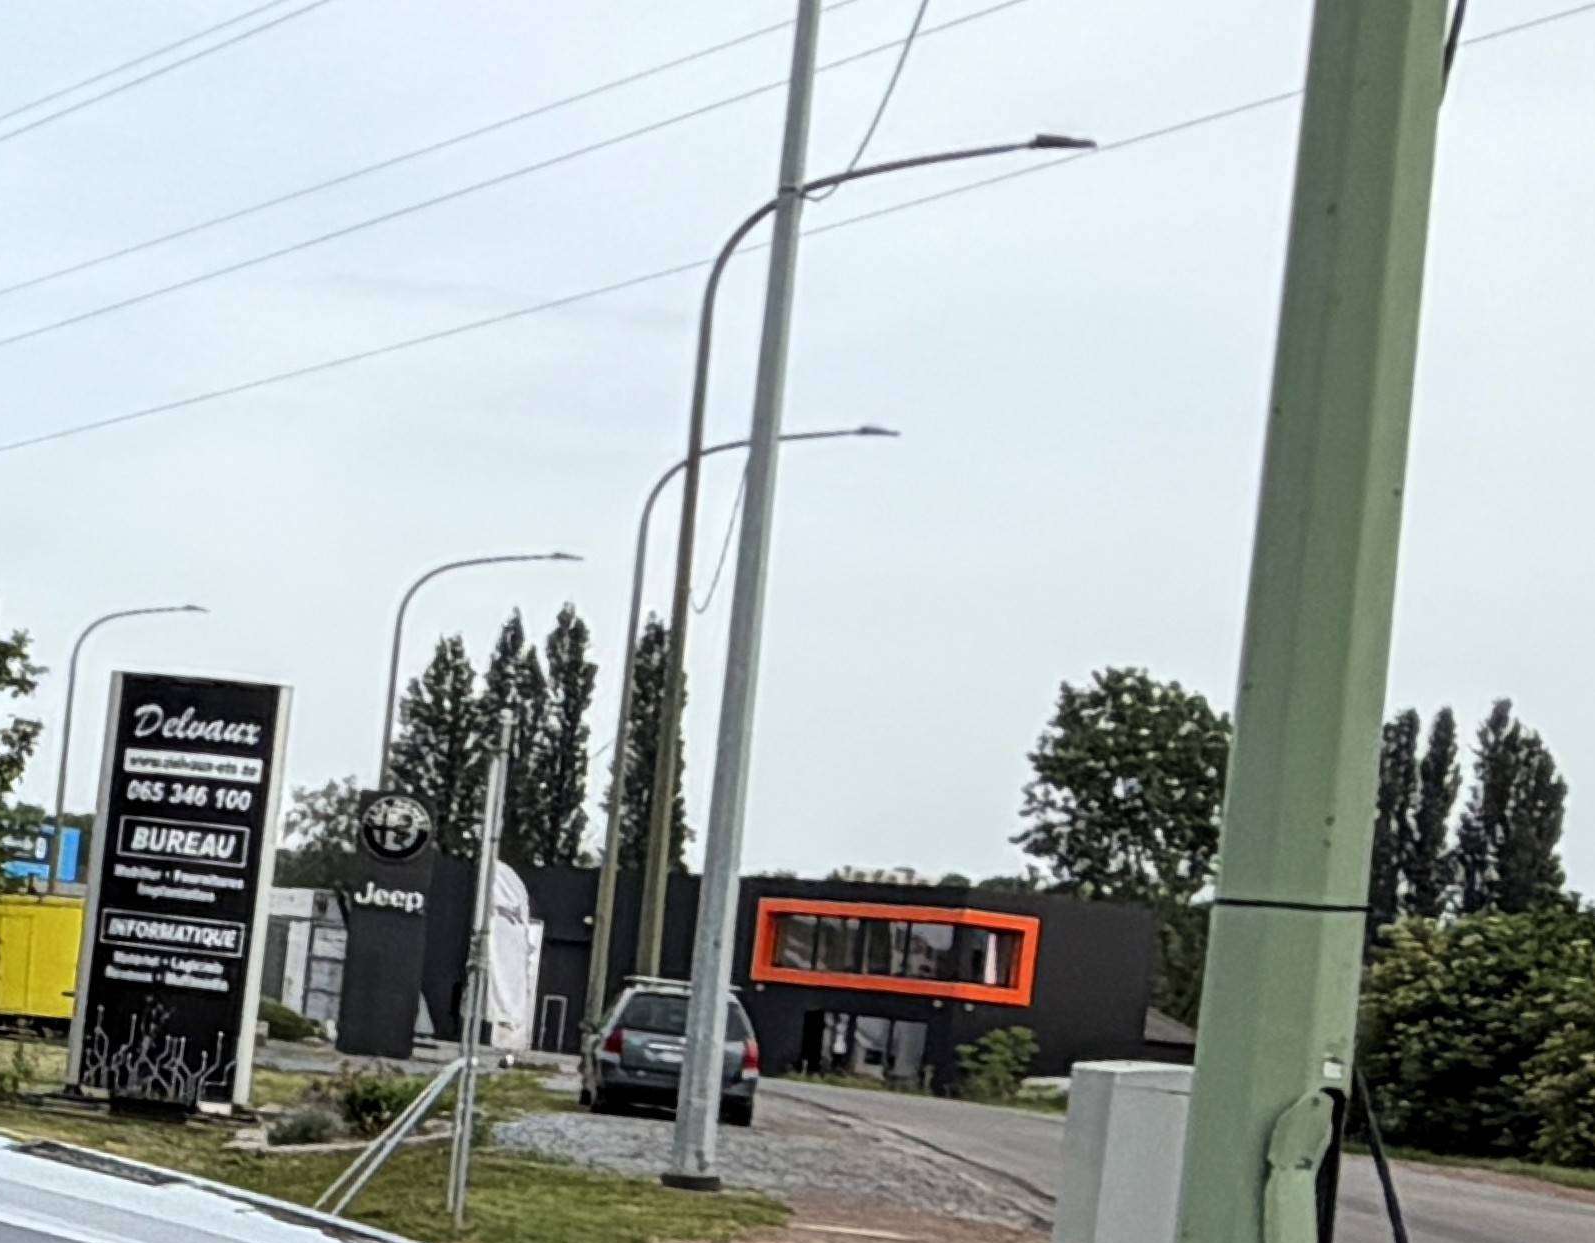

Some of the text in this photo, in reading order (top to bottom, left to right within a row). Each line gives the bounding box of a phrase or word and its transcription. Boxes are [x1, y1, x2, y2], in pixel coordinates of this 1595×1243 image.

[133, 703, 261, 745] Delvaux
[127, 779, 252, 812] 065 346 100
[131, 826, 236, 859] BUREAU
[354, 881, 425, 912] Jeep
[108, 917, 237, 949] INFORMATIQUE
